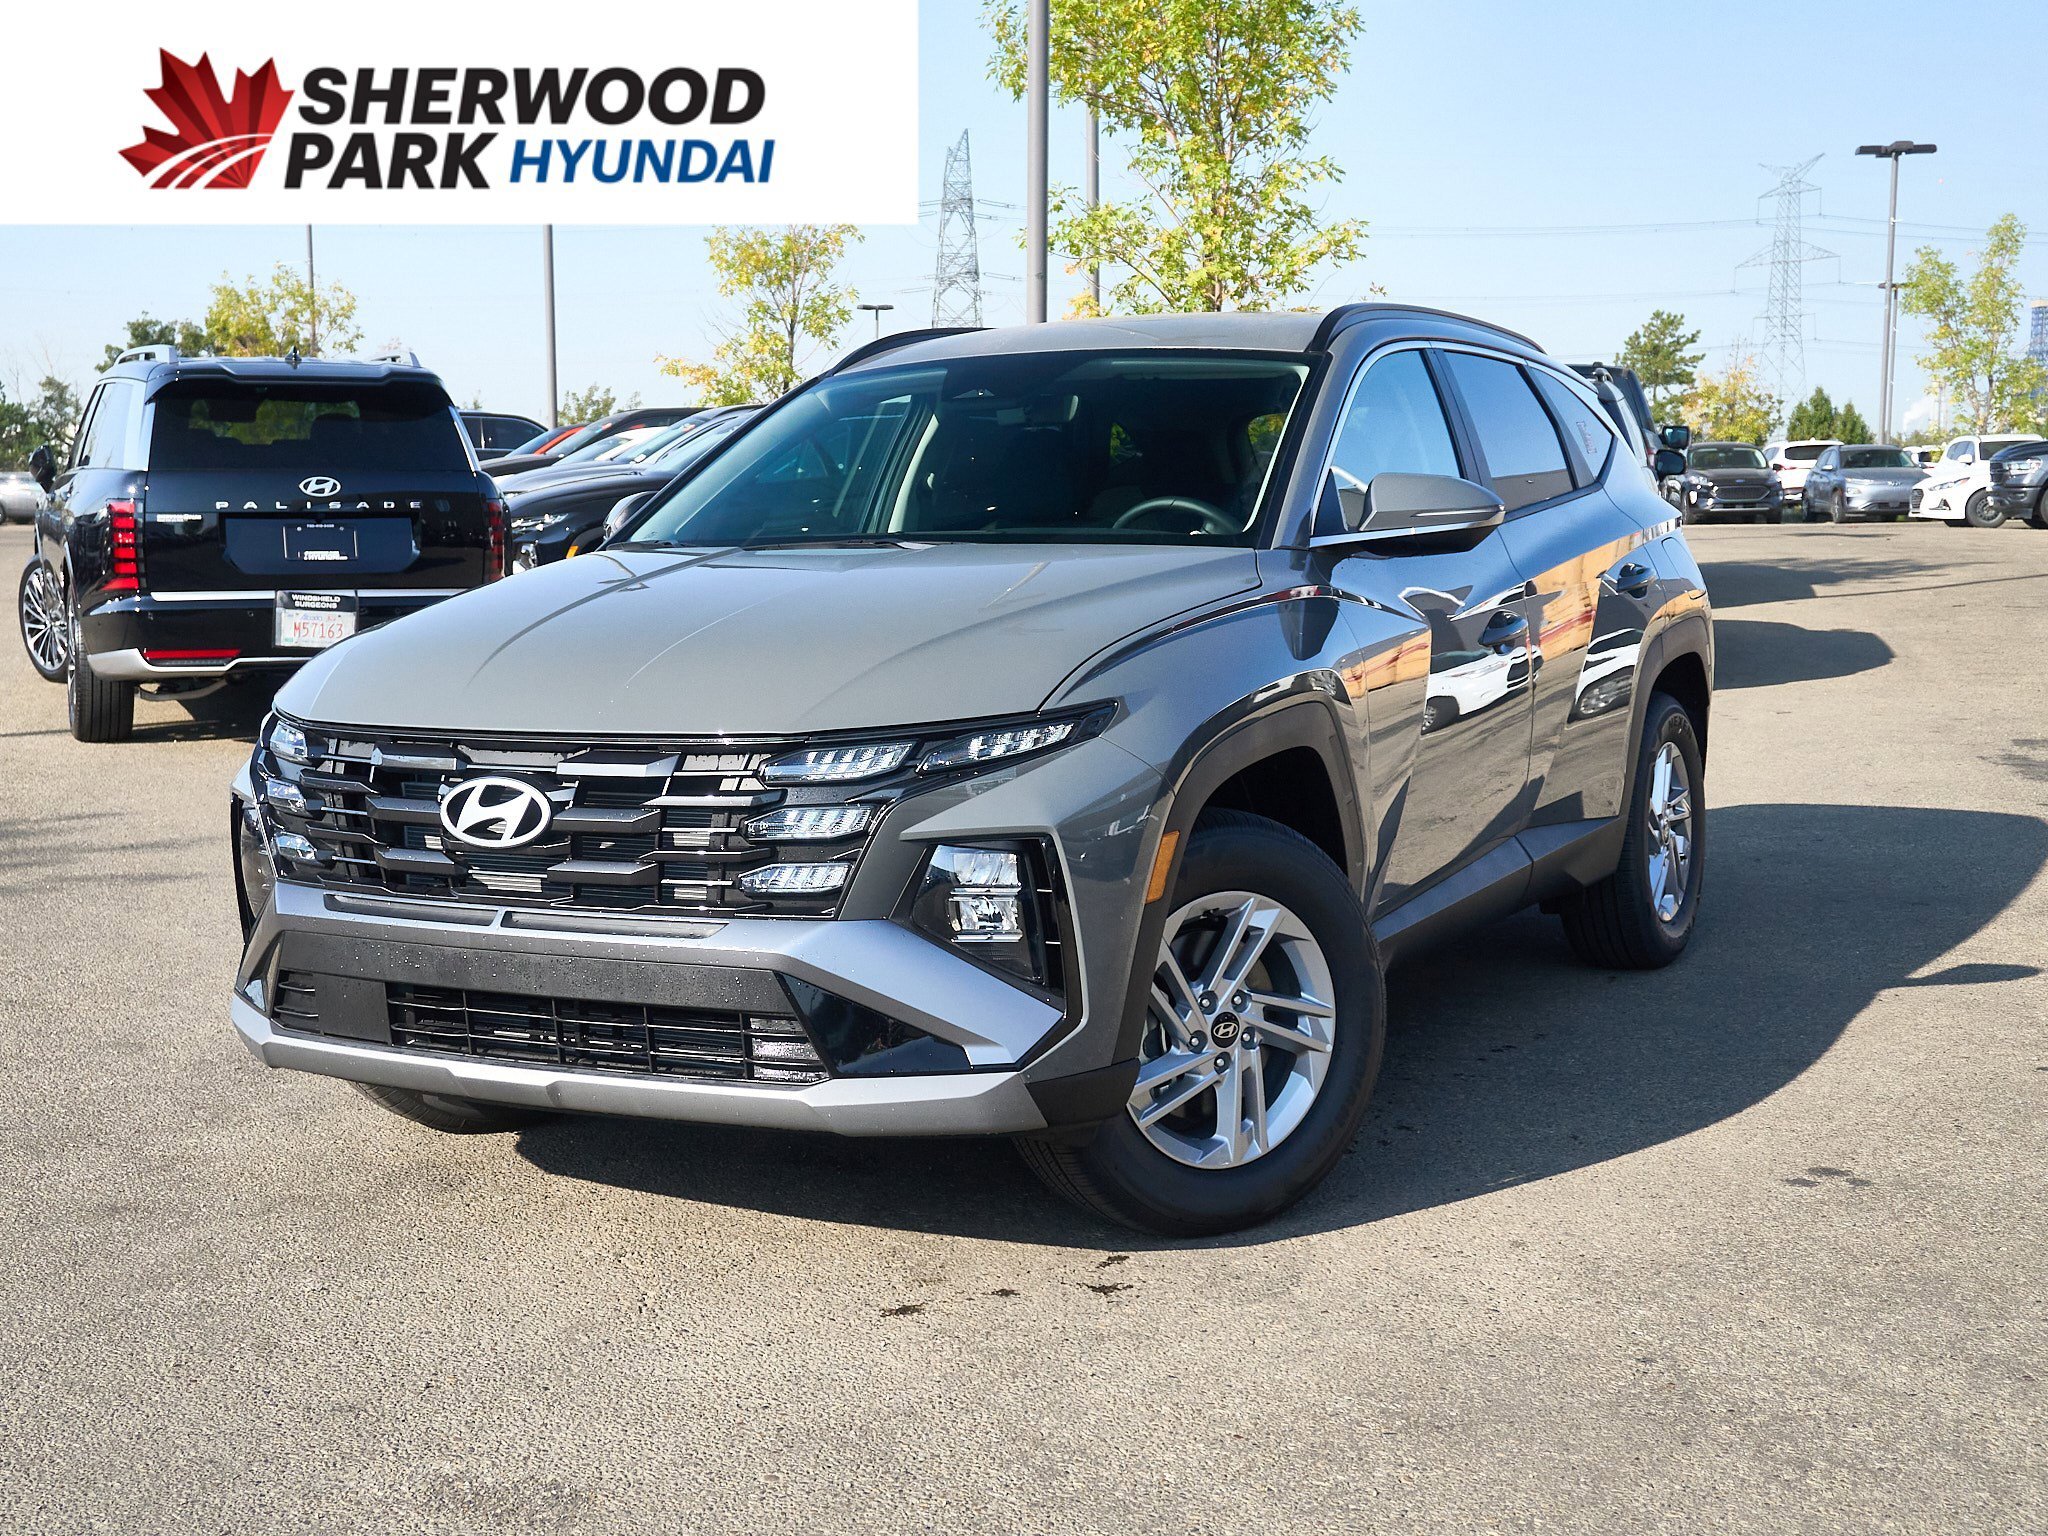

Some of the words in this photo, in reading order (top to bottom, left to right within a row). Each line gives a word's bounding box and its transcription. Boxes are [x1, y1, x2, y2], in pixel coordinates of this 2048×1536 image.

[215, 501, 421, 510] PALISADE
[291, 594, 341, 603] WINDSHIELD
[294, 601, 338, 609] SURGEONS
[293, 622, 344, 639] M57163
